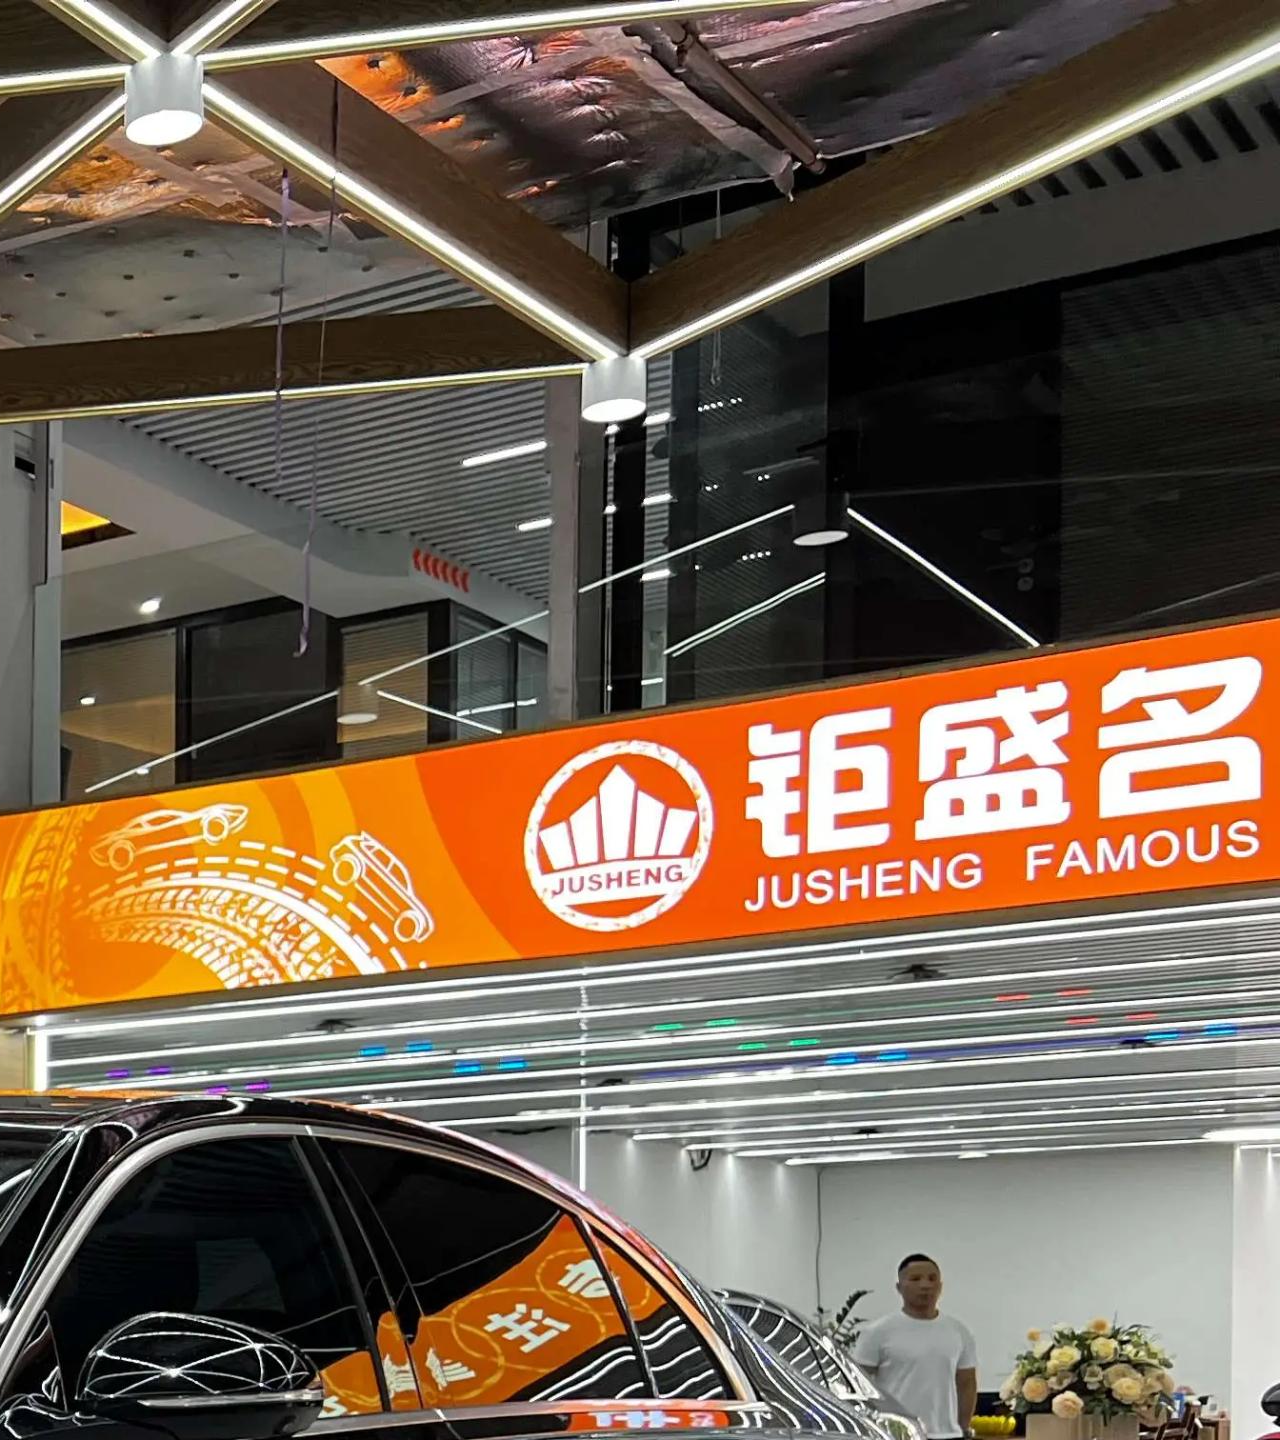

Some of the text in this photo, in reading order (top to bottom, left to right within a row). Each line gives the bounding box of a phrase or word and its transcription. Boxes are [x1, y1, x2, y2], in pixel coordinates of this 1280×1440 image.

[745, 656, 1262, 858] 钜盛名
[551, 864, 684, 898] JUSHENG
[745, 819, 1261, 912] JUSHENG FAMOUS
